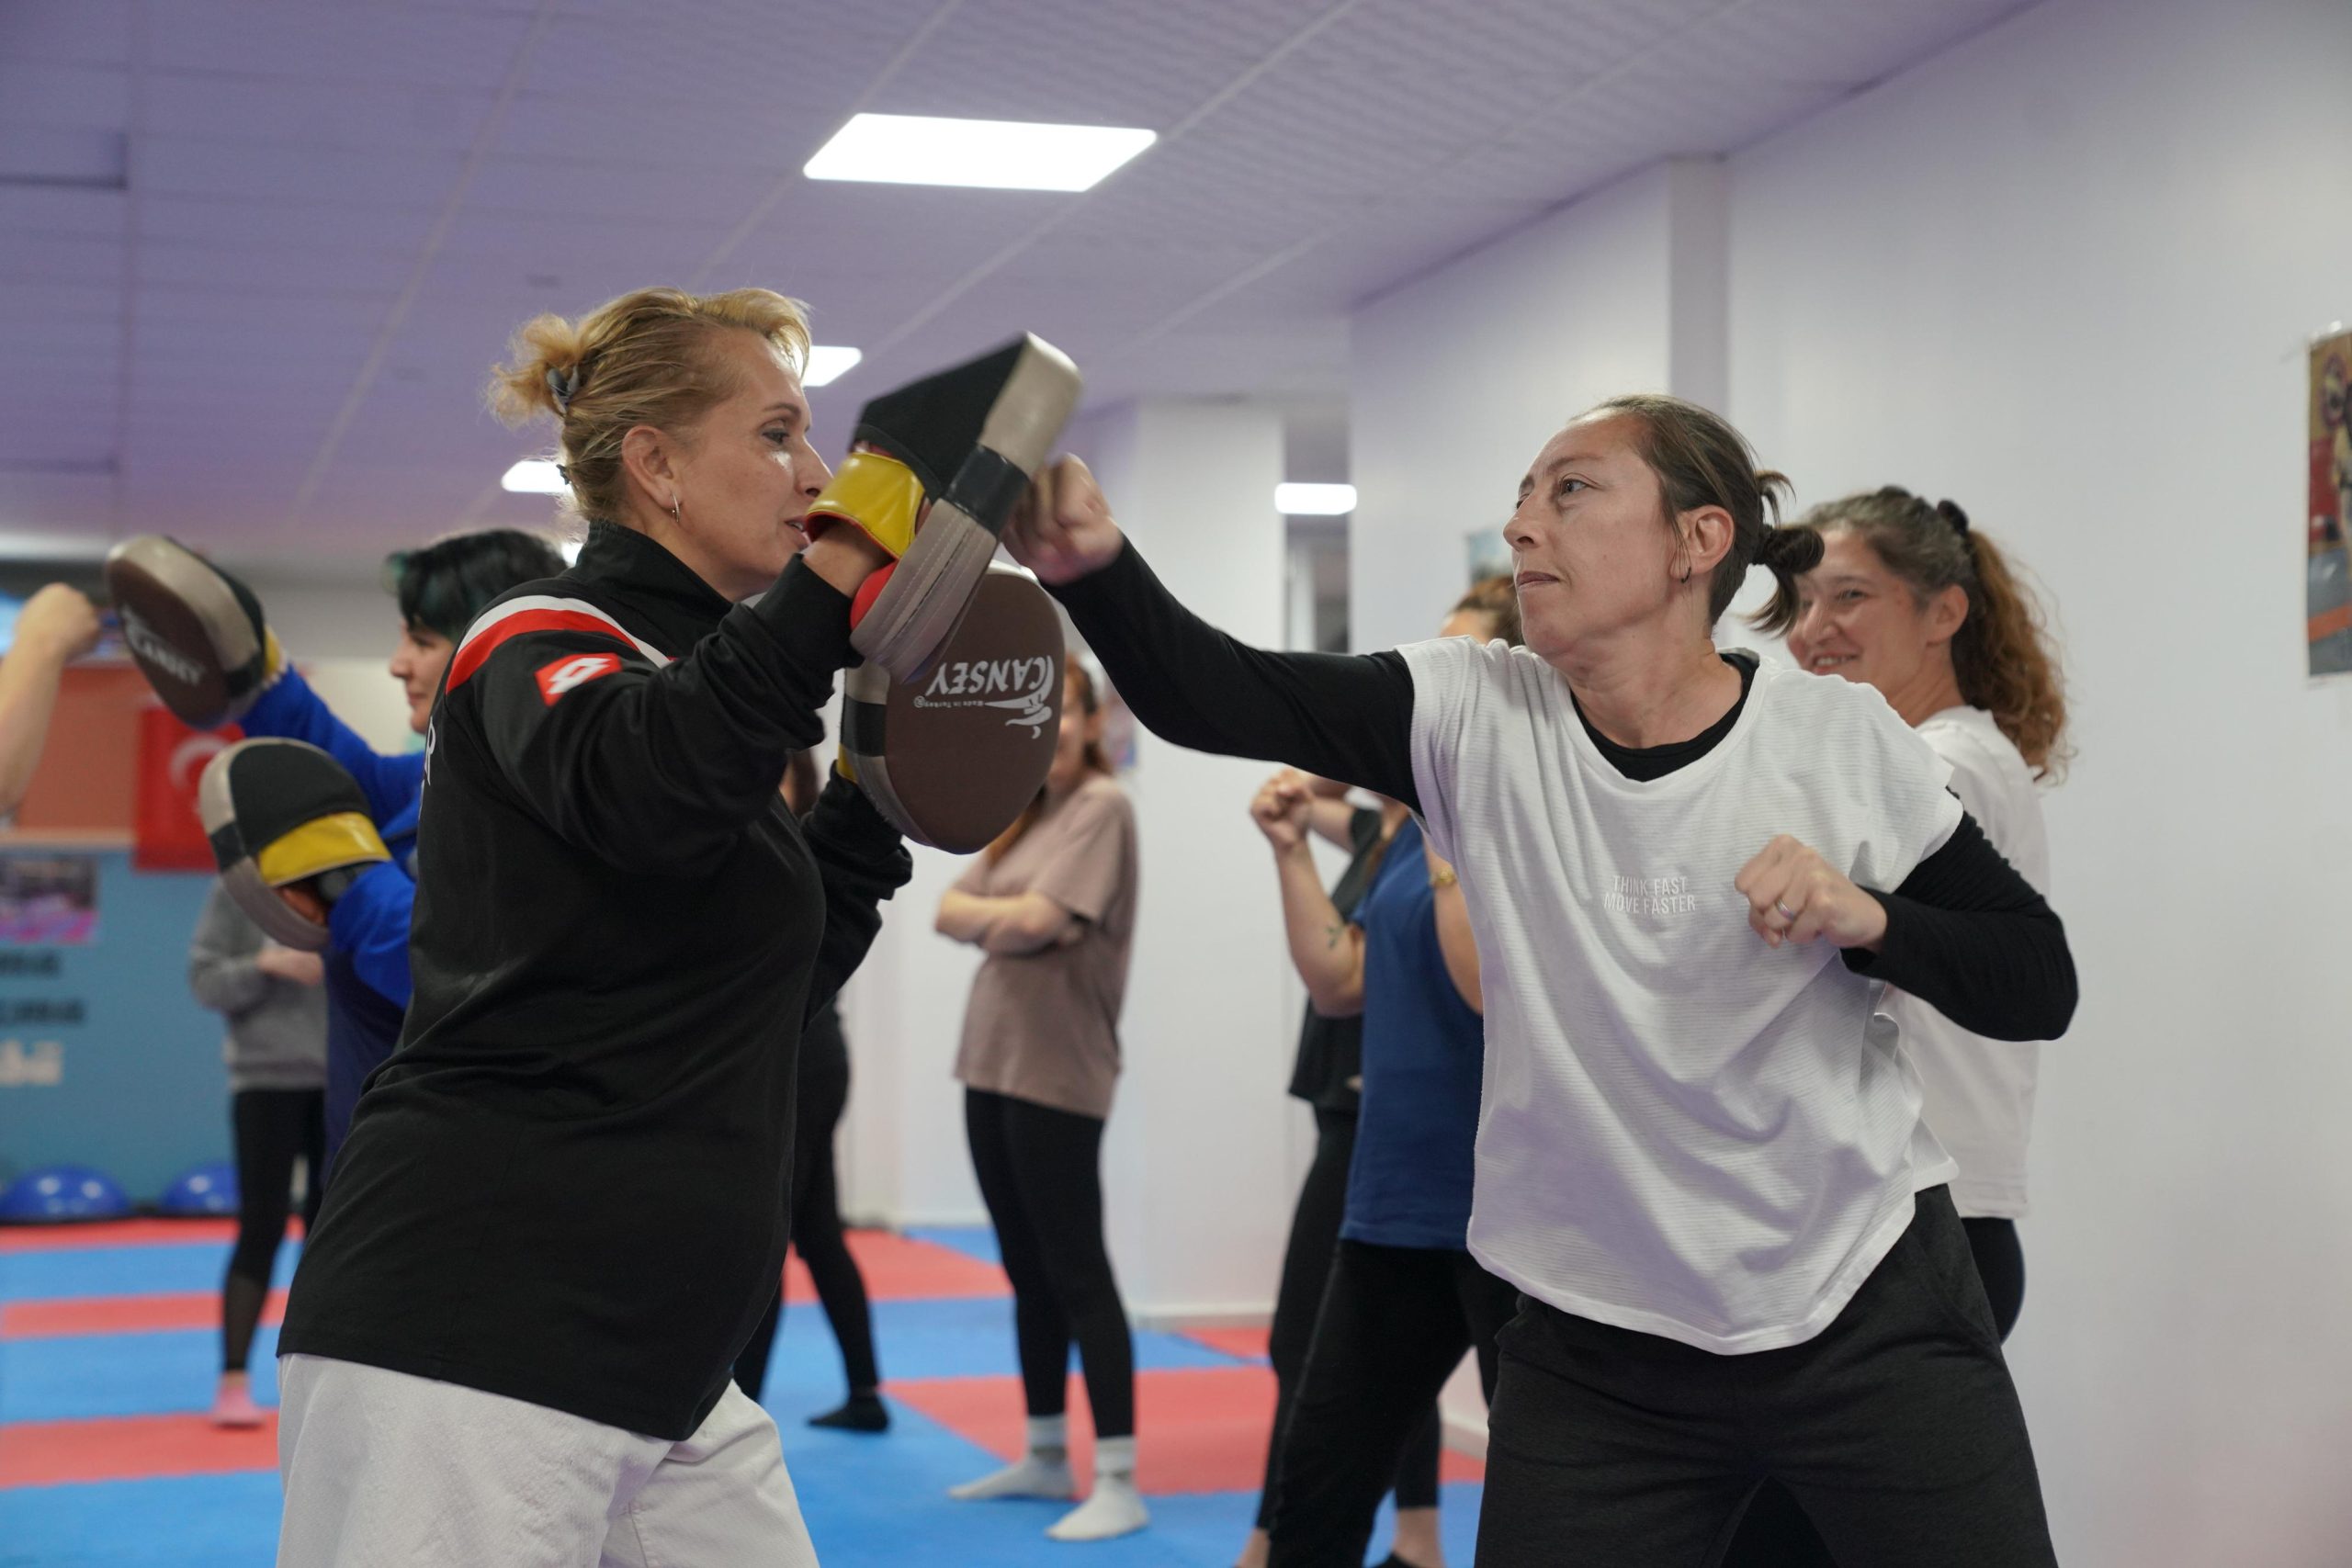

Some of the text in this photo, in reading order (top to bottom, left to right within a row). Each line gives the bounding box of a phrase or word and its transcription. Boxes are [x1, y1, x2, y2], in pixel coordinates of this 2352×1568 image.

[924, 655, 1055, 701] CANSEY
[1611, 874, 1688, 897] THINK FAST
[1603, 892, 1696, 915] MOVE FASTER
